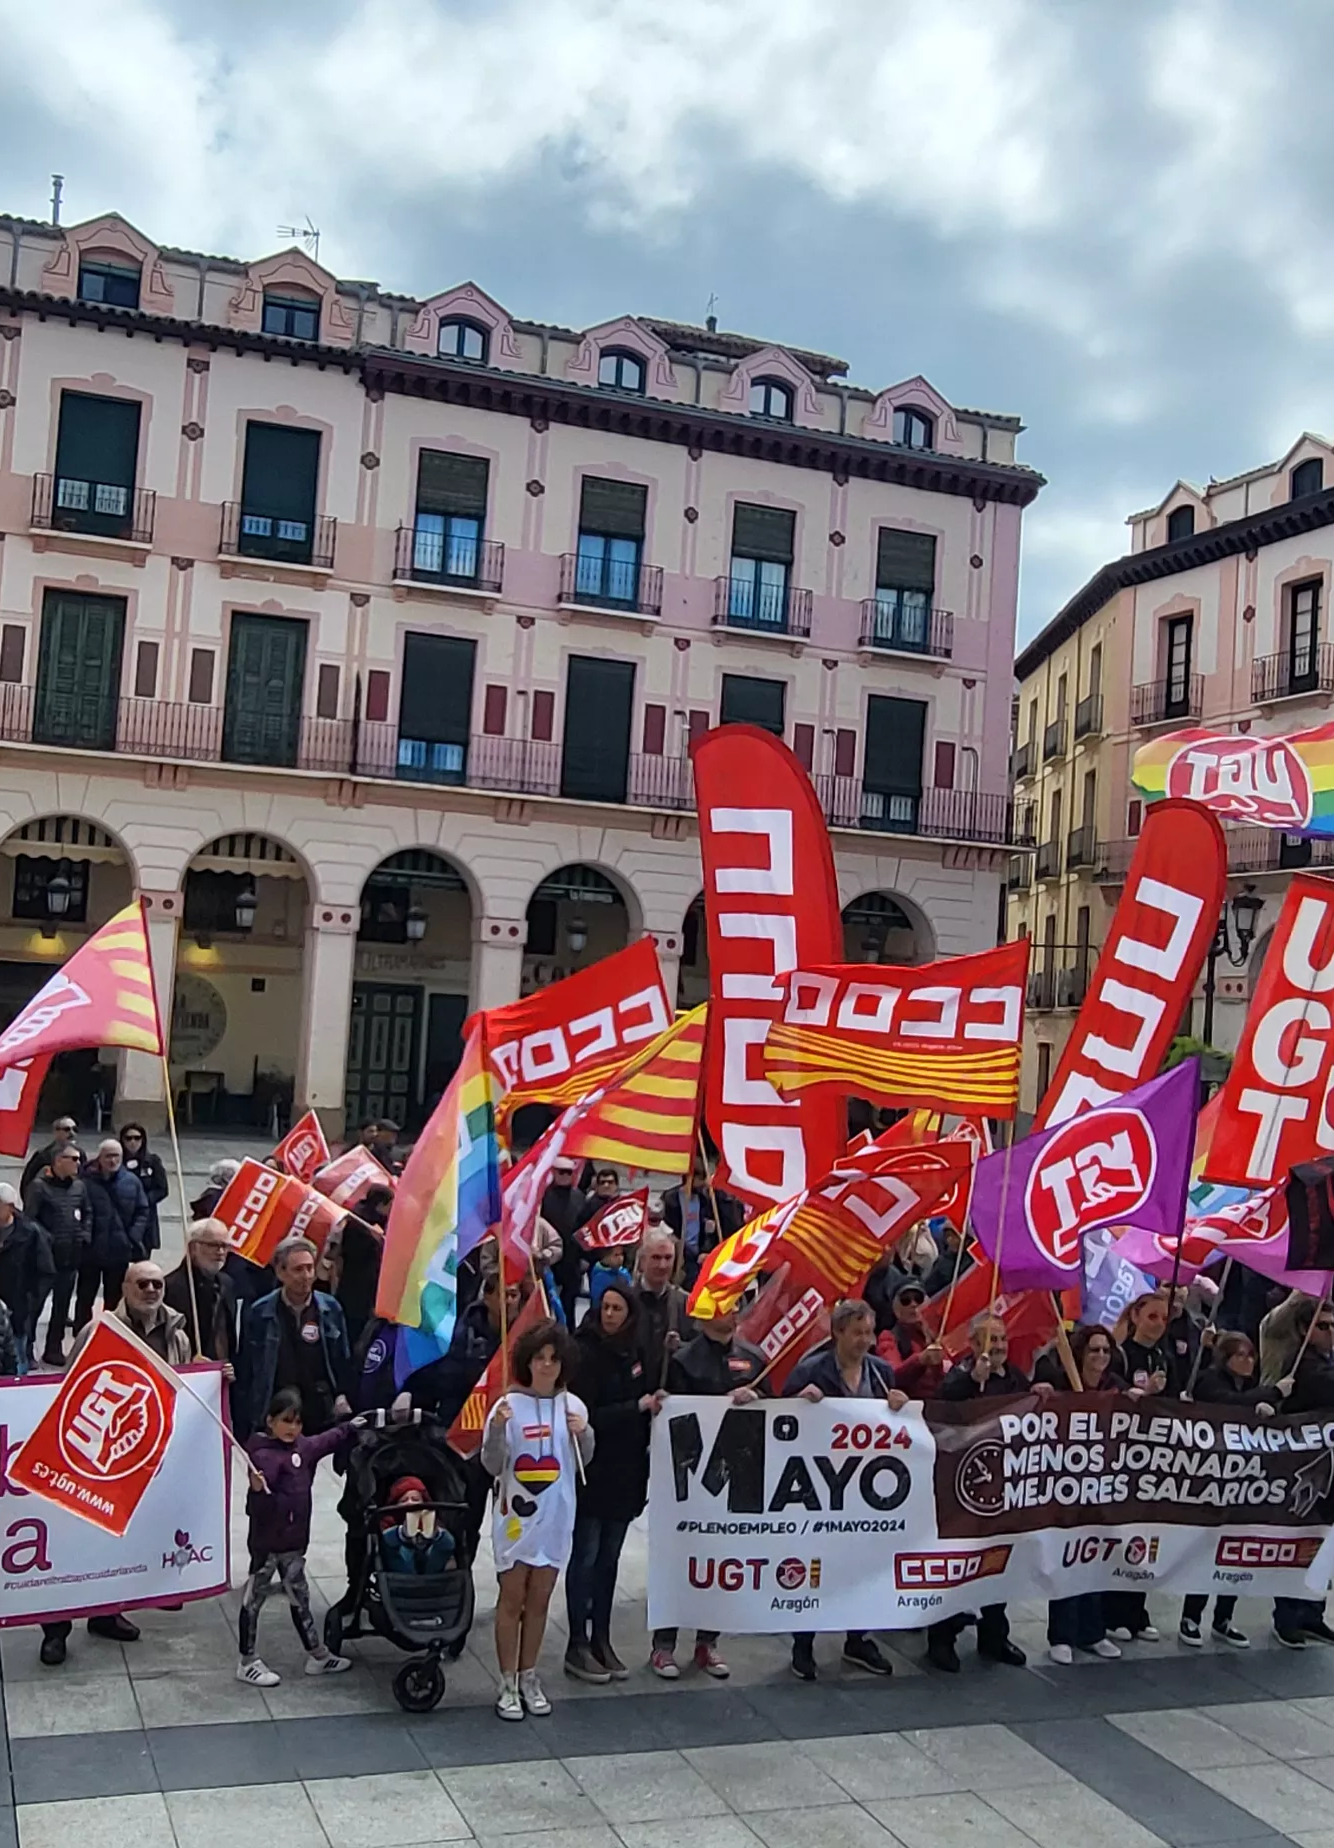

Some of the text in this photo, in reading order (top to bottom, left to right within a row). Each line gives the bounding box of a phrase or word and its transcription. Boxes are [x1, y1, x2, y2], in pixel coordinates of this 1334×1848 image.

[227, 1171, 278, 1248] CCOO
[66, 1369, 136, 1463] UGT
[999, 1411, 1058, 1444] POR
[1068, 1411, 1106, 1441] EL
[1109, 1411, 1216, 1450] PLENO
[830, 1424, 912, 1450] 2024
[1002, 1443, 1267, 1480] MENOS JORNADA,
[31, 1461, 115, 1517] www.ugt.es
[1003, 1474, 1288, 1512] MEJORES SALARIOS
[676, 1518, 906, 1536] #PLENOEMPLEO / #1MAYO2024
[1062, 1536, 1123, 1569] UGT
[1220, 1540, 1298, 1564] CCOO
[688, 1556, 769, 1591] UGT
[899, 1555, 982, 1584] CCOO
[1112, 1567, 1156, 1582] Aragón
[1212, 1569, 1254, 1586] Aragón
[770, 1596, 820, 1614] Aragón
[897, 1594, 944, 1610] Aragón
